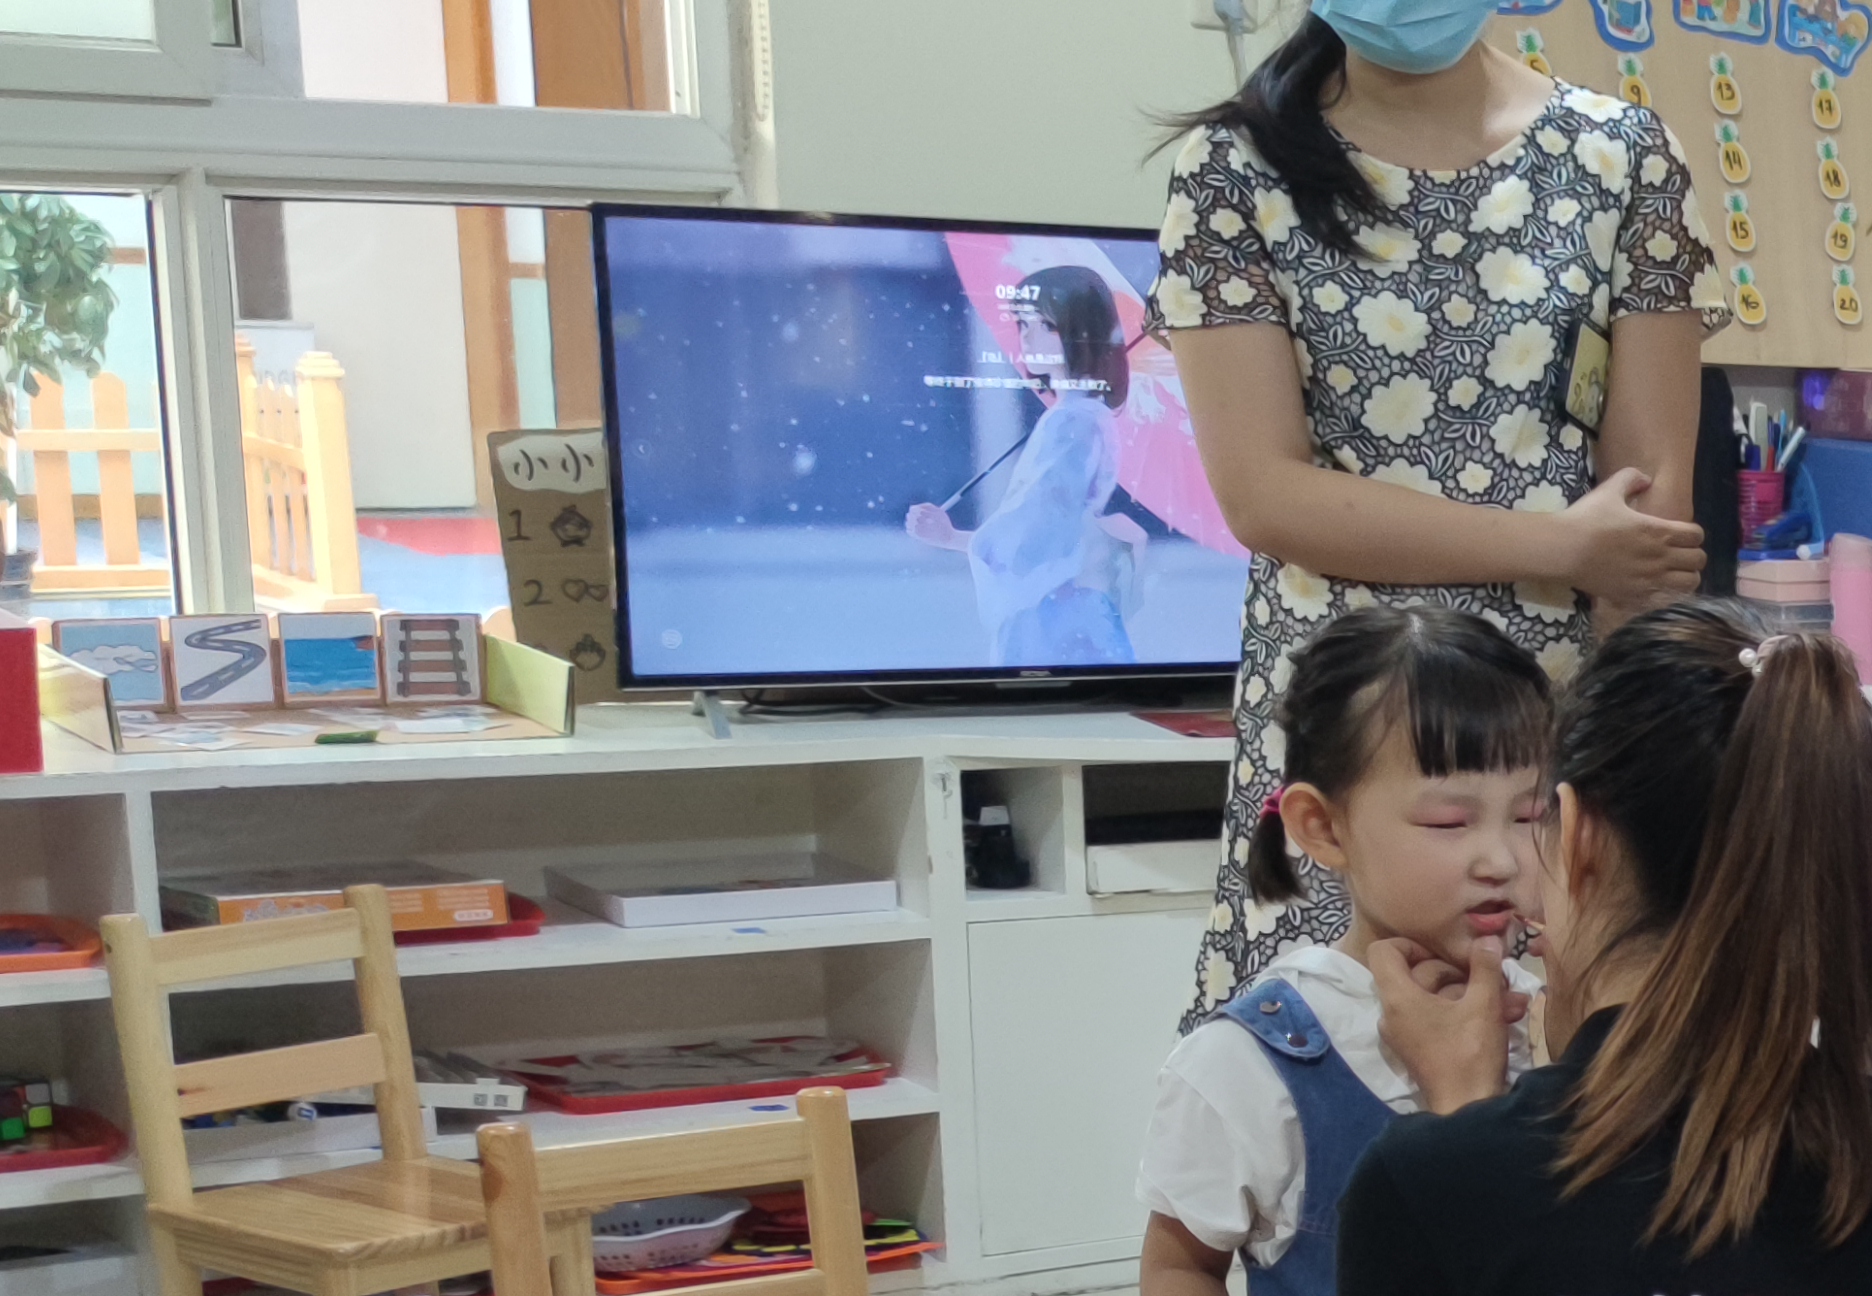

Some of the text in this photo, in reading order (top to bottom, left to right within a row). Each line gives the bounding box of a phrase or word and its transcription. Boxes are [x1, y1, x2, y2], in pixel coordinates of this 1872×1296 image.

[1630, 84, 1642, 106] 9
[1716, 81, 1735, 101] 13
[1817, 98, 1833, 116] 17
[1725, 150, 1742, 171] 14
[1824, 169, 1841, 188] 18
[1732, 220, 1749, 239] 15
[1831, 230, 1848, 249] 19
[995, 284, 1041, 300] 09:47
[1741, 294, 1759, 312] 16
[1839, 298, 1859, 313] 20
[508, 509, 532, 541] 1
[524, 579, 552, 607] 2
